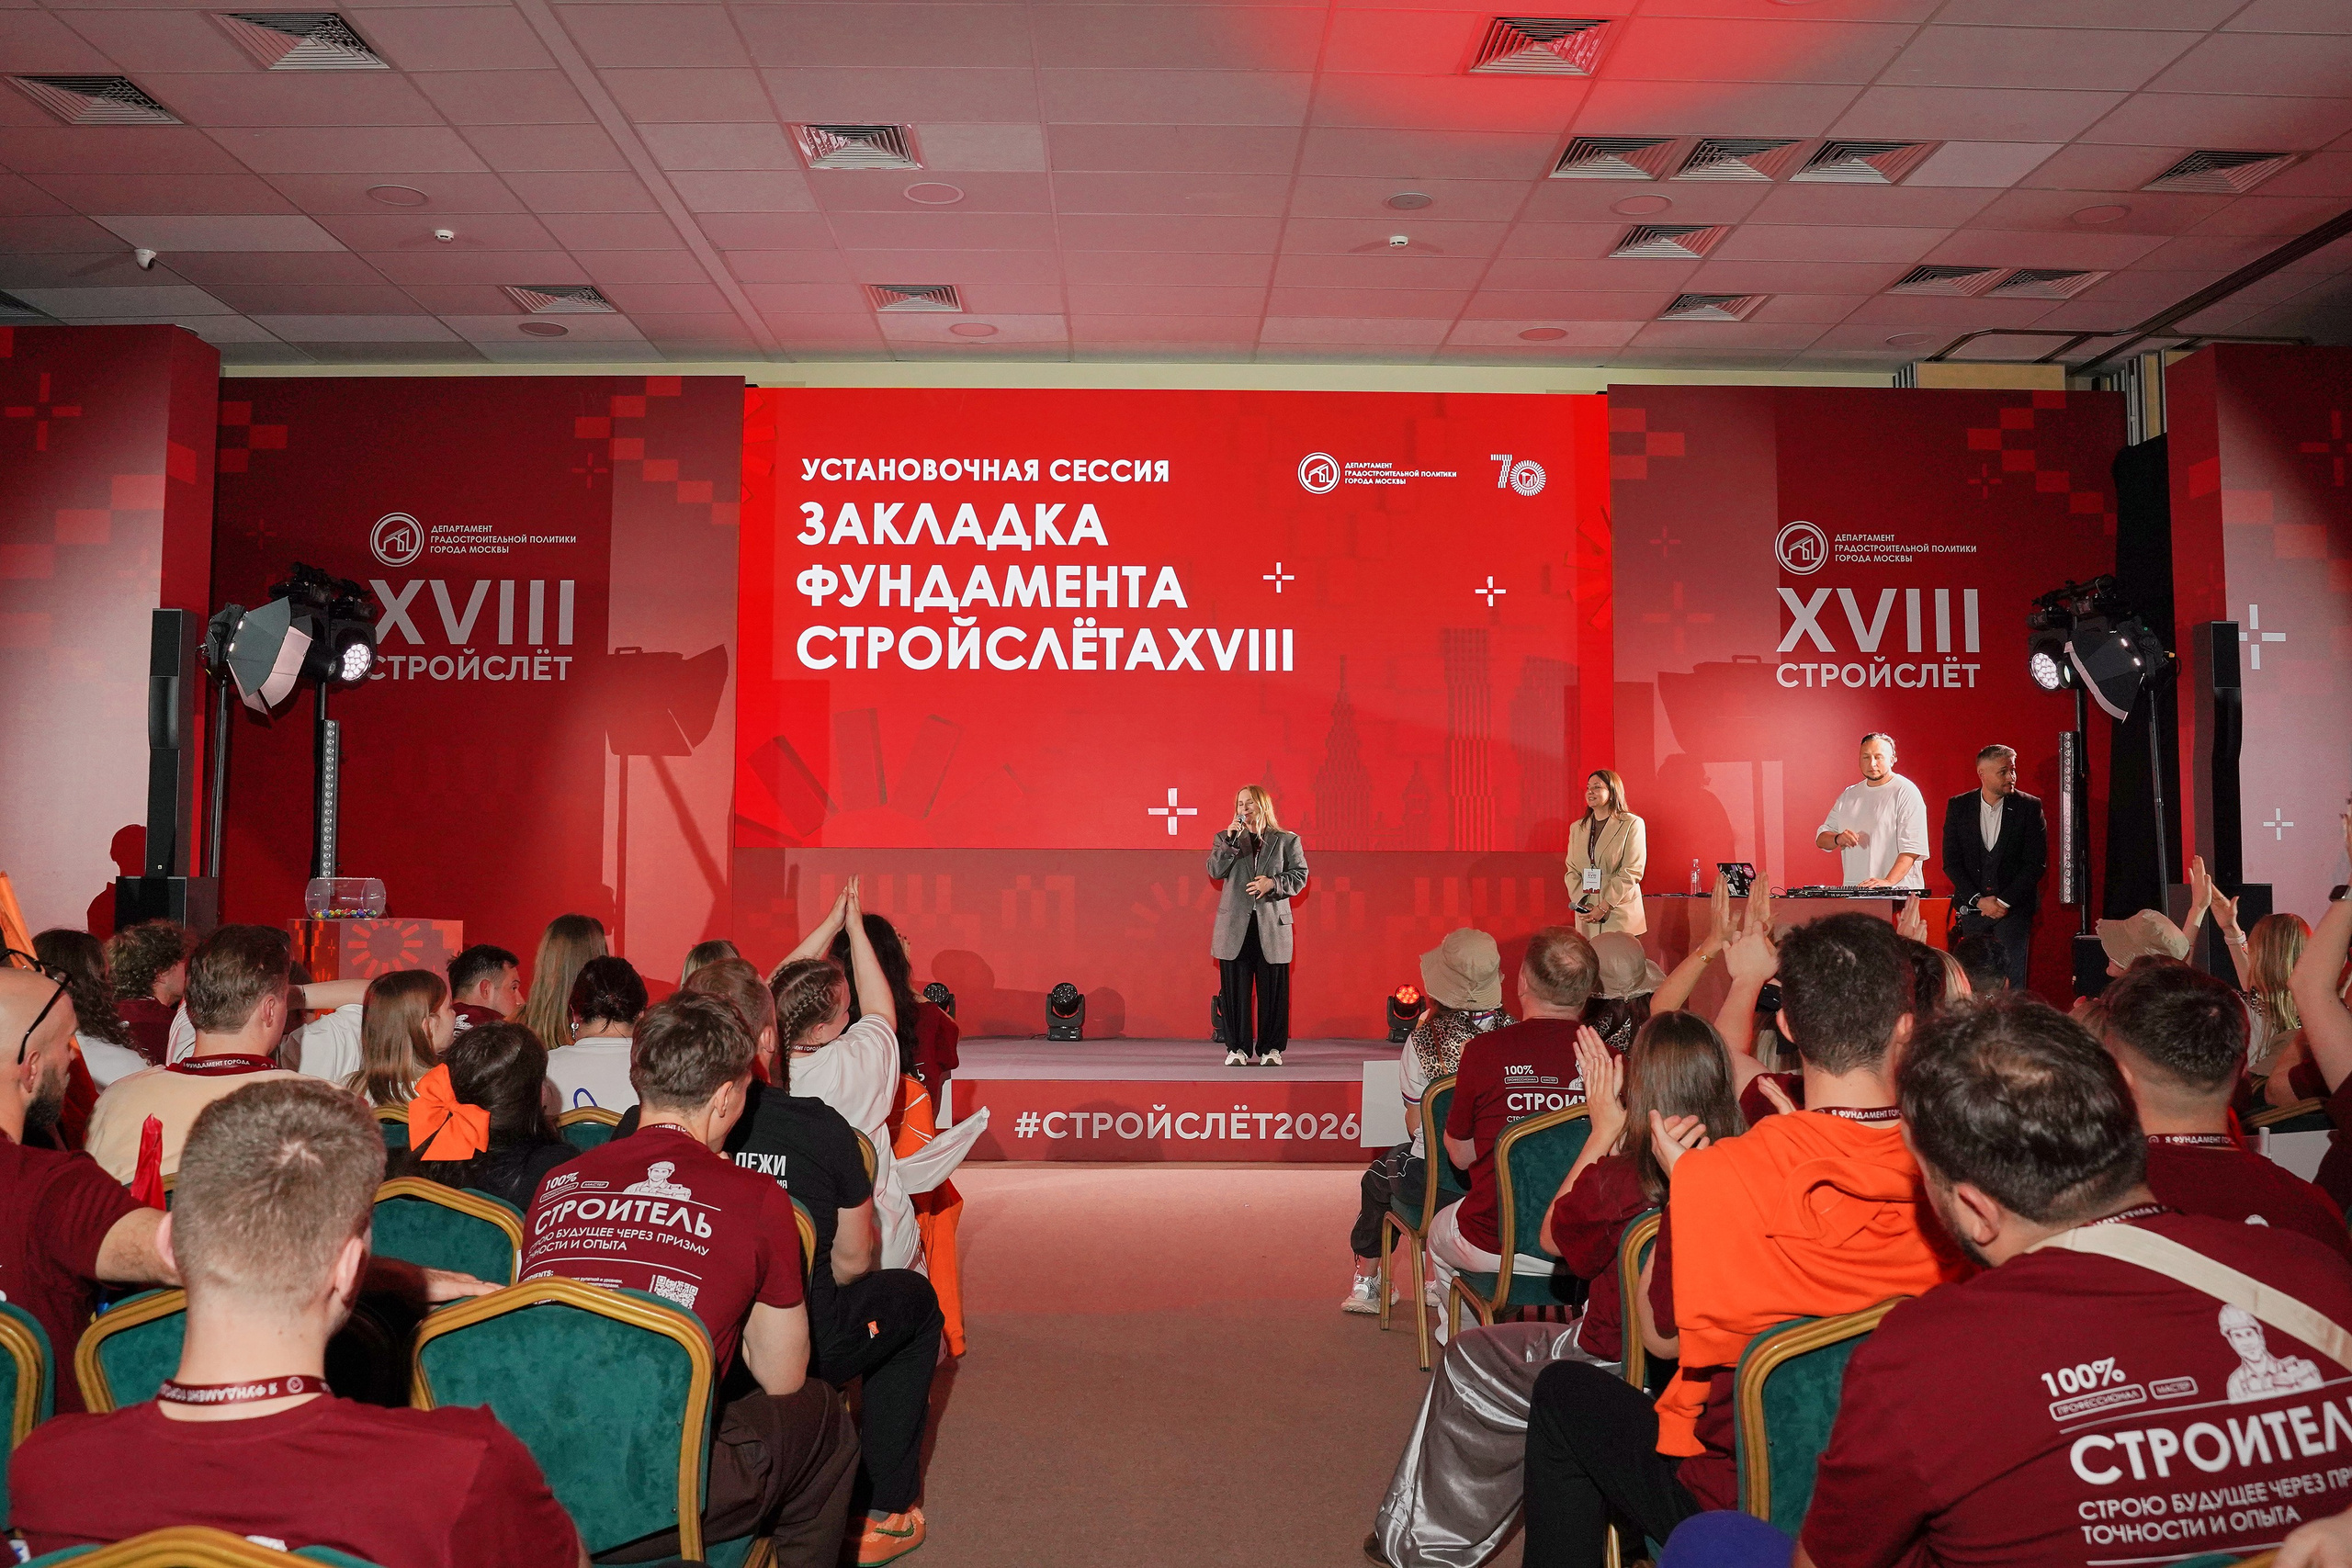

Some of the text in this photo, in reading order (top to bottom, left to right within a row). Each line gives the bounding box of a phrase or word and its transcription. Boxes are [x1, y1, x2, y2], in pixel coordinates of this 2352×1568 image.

[801, 458, 1170, 483] УСТАНОВОЧНАЯ СЕССИЯ
[1344, 469, 1419, 478] ГРАДОСТРОИТЕЛЬНОЙ
[1344, 478, 1374, 486] ГОРОДА
[431, 525, 493, 534] ДЕПАРТАМЕНТ
[796, 501, 1110, 552] ЗАКЛАДКА
[430, 535, 576, 545] ГРАДОСТРОИТЕЛЬНОЙ ПОЛИТИКИ
[1834, 534, 1895, 543] ДЕПАРТАМЕНТ
[430, 546, 509, 555] ГОРОДА МОСКВЫ
[1834, 544, 1977, 554] ГРАДОСТРОИТЕЛЬНОЙ ПОЛИТИКИ
[1835, 554, 1913, 563] ГОРОДА МОСКВЫ
[796, 563, 1189, 614] ФУНДАМЕНТА
[368, 580, 575, 646] XVIII
[1776, 587, 1980, 653] XVIII
[1776, 656, 1981, 689] СТРОЙСЛЁТ
[223, 1058, 250, 1066] ГОРОДА
[1504, 1065, 1534, 1076] 100%
[1013, 1104, 1361, 1141] #СТРОЙСЛЁТ2026
[1838, 1110, 1887, 1120] ФУНДАМЕНТ
[2165, 1135, 2171, 1144] Я
[2172, 1135, 2222, 1145] ФУНДАМЕНТ
[545, 1171, 579, 1191] 100%
[535, 1198, 713, 1239] СТРОИТЕЛЬ
[555, 1226, 616, 1238] БУДУЩЕЕ
[616, 1228, 653, 1241] ЧЕРЕЗ
[657, 1233, 710, 1257] ПРИЗМУ
[570, 1239, 581, 1249] И
[582, 1239, 628, 1251] ОПЫТА
[2041, 1356, 2127, 1397] 100%
[268, 1382, 278, 1395] Я
[2056, 1381, 2192, 1416] ПРОФЕССИОНАЛ МАСТЕР
[2069, 1396, 2352, 1485] СТРОИТЕЛ
[2077, 1495, 2167, 1521] СТРОЮ
[2171, 1485, 2269, 1514] БУДУЩЕЕ
[2267, 1472, 2326, 1500] ЧЕРЕЗ
[2080, 1505, 2303, 1546] ТОЧНОСТИ И ОПЫТА
